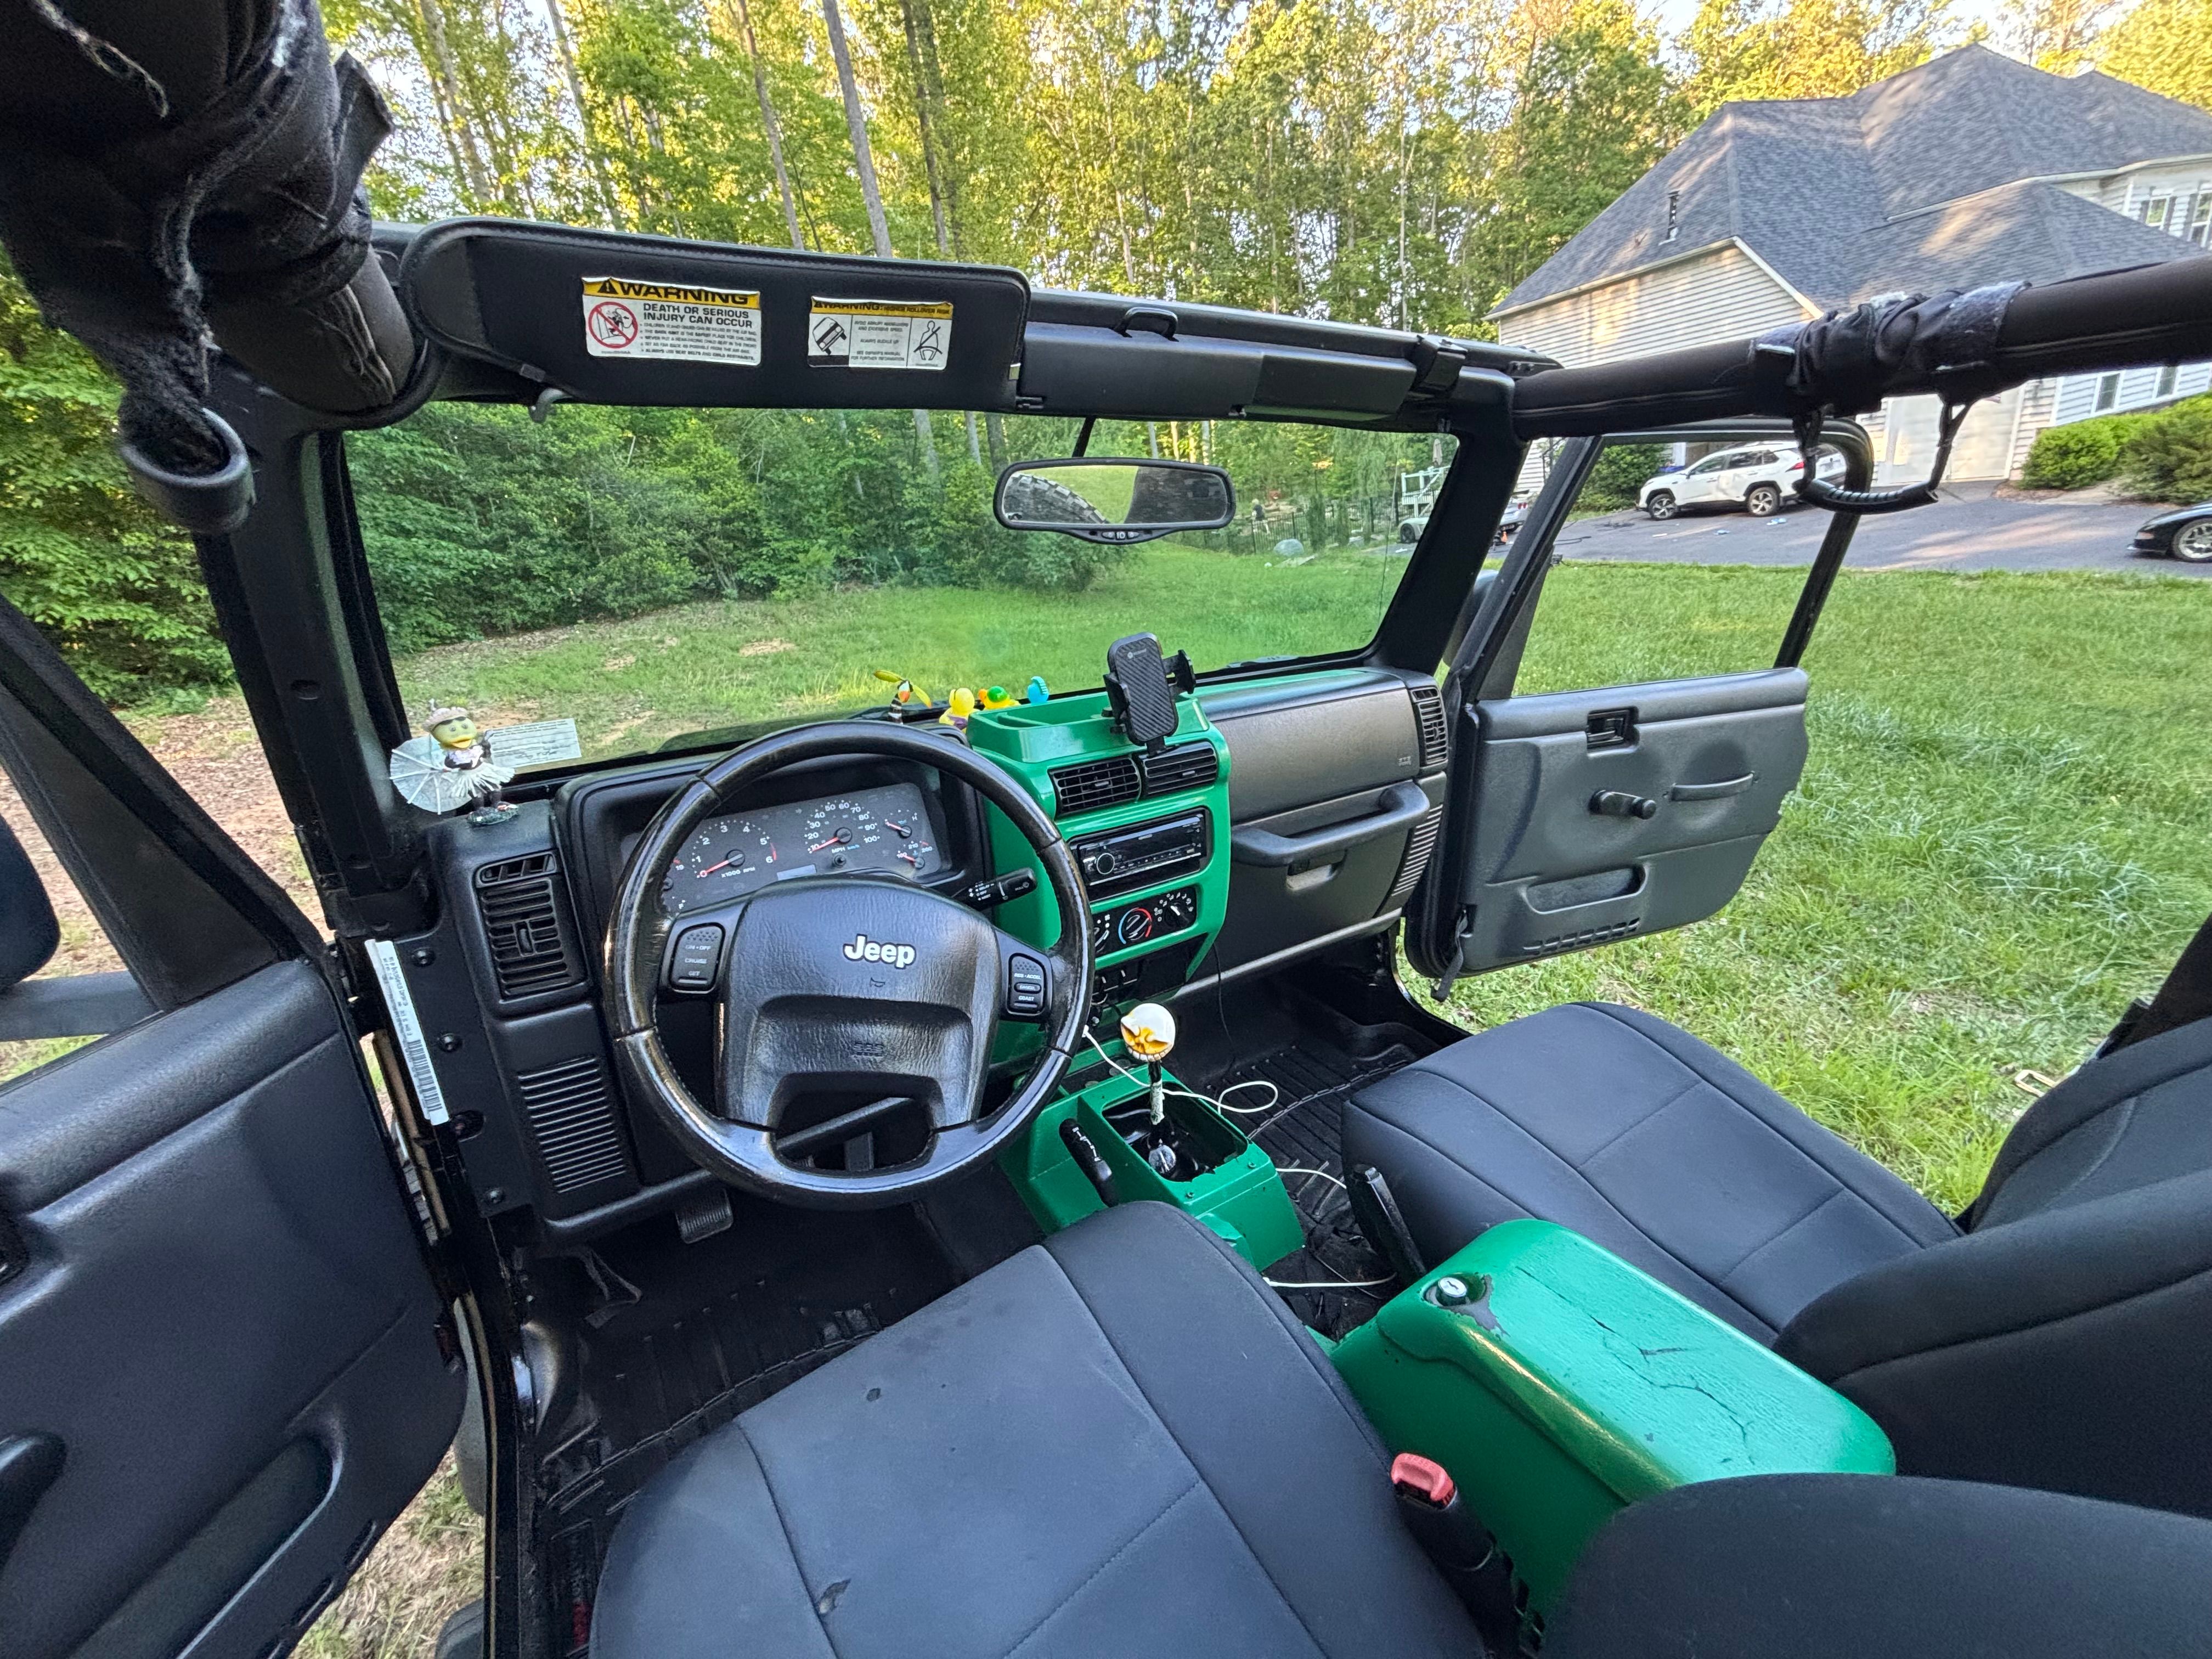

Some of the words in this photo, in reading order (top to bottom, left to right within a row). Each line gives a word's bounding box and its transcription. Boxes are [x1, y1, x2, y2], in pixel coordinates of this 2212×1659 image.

[620, 283, 748, 304] WARNING
[642, 302, 679, 313] DEATH
[683, 306, 698, 314] OR
[702, 308, 748, 318] SERIOUS
[643, 312, 684, 322] INJURY
[689, 315, 712, 324] CAN
[715, 317, 752, 328] OCCUR
[702, 837, 710, 845] 2
[843, 934, 916, 969] Jeep
